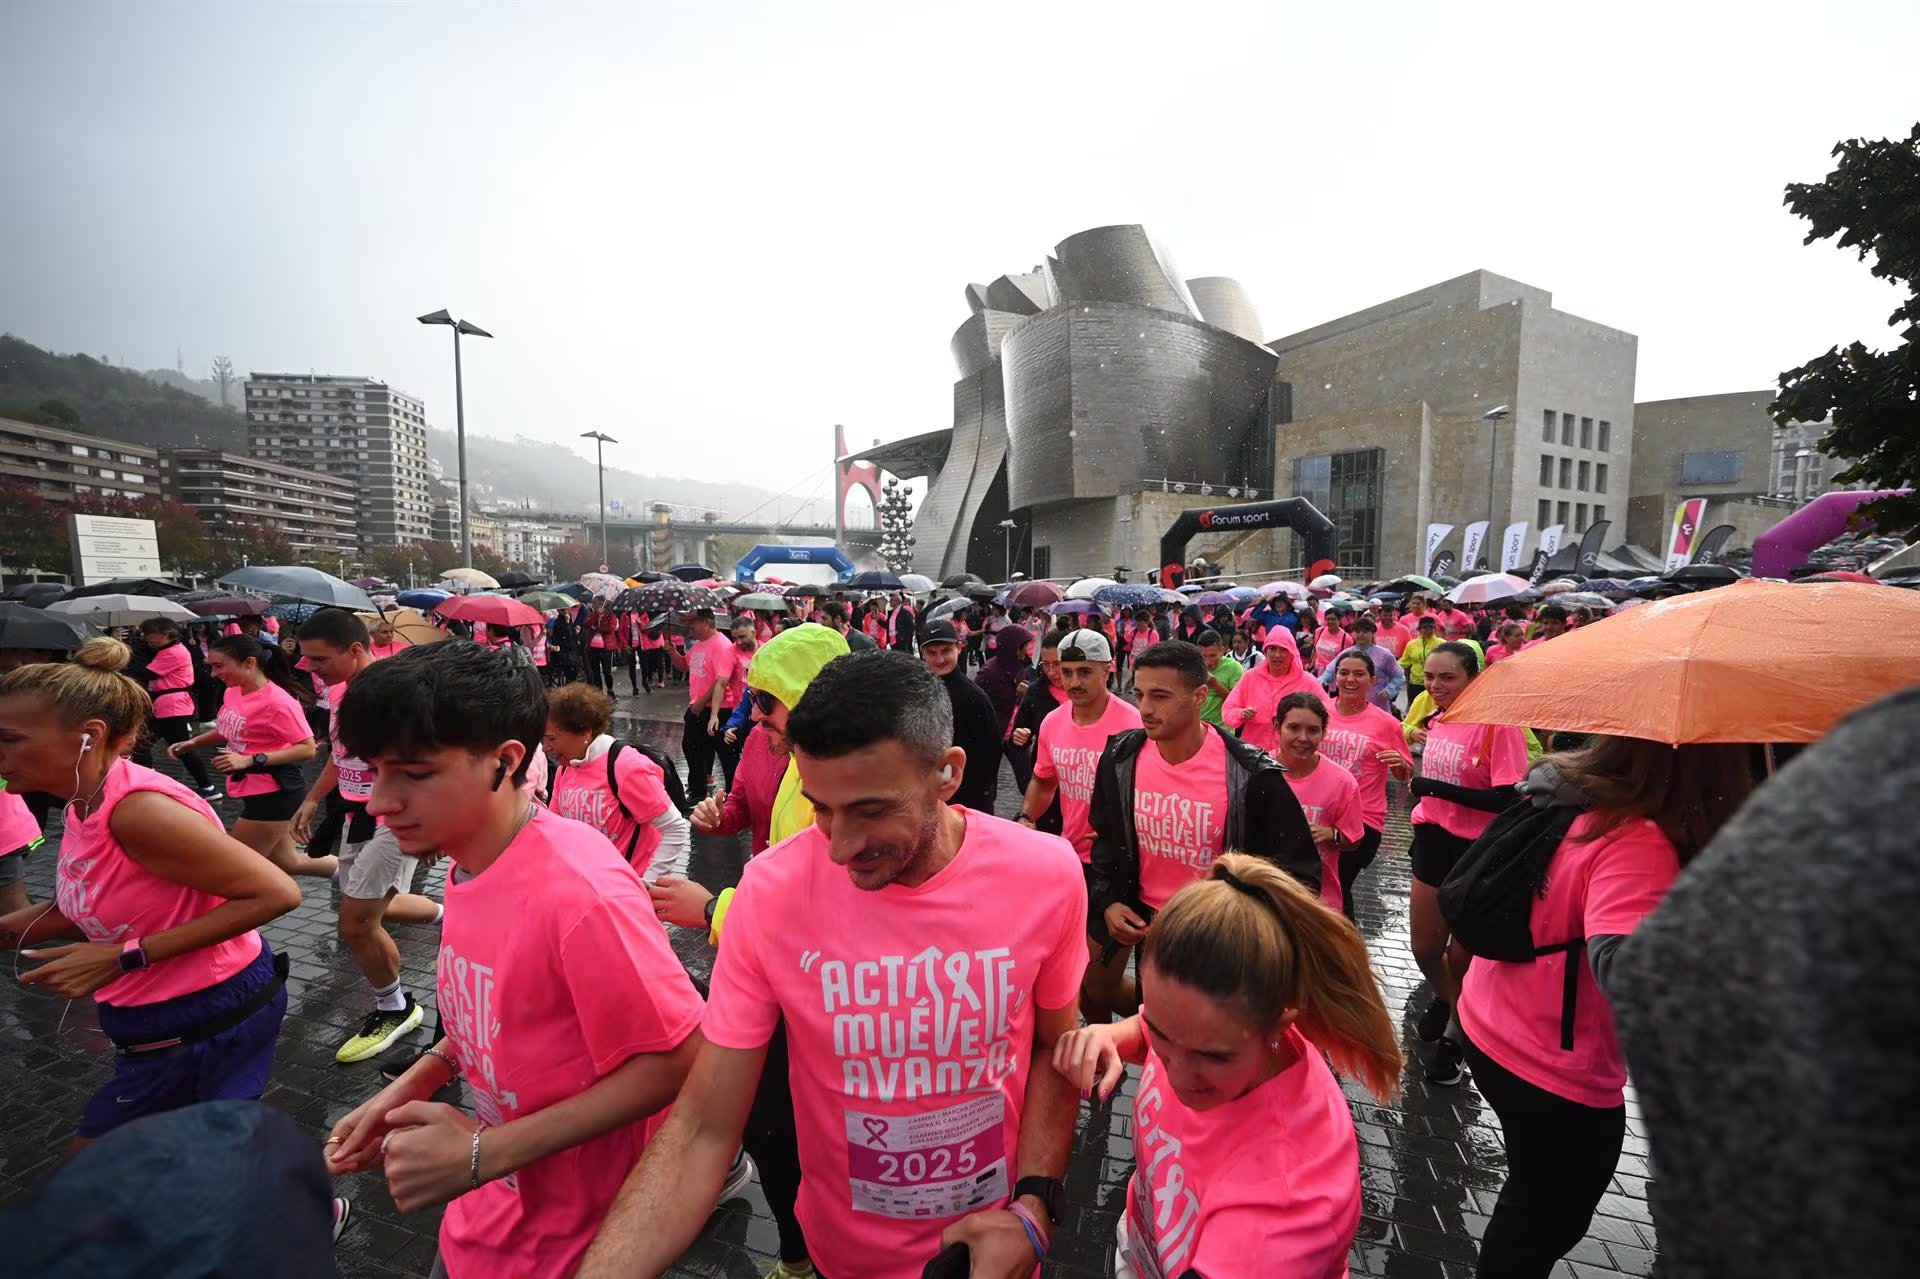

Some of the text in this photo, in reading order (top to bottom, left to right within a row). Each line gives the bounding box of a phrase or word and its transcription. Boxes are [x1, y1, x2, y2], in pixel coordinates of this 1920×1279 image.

[1242, 512, 1270, 524] sport
[1510, 534, 1520, 554] sport
[340, 767, 362, 782] 2025
[878, 1140, 976, 1182] 2025
